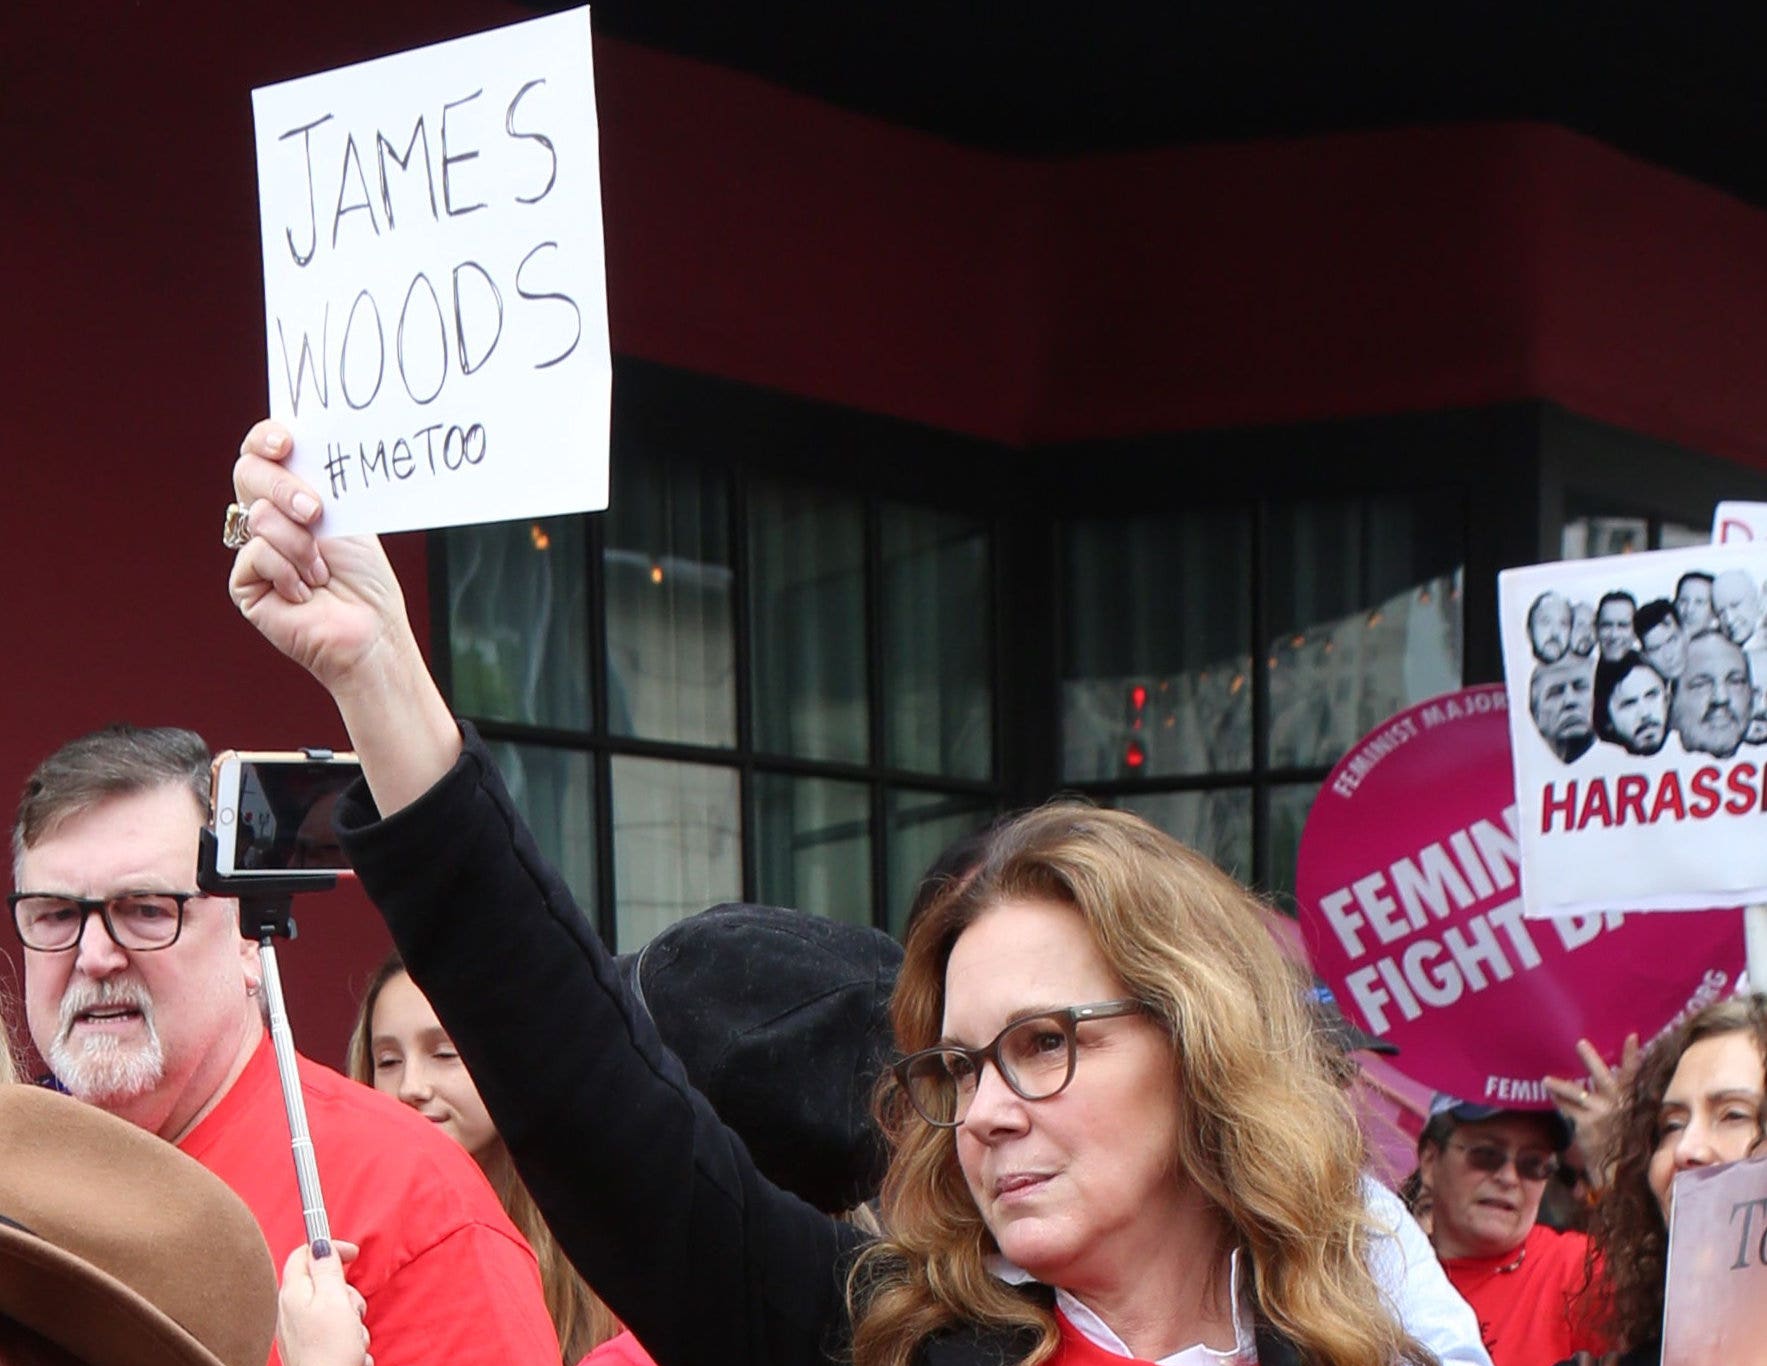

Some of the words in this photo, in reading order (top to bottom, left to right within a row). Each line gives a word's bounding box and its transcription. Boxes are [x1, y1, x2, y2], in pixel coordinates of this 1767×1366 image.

[279, 79, 557, 267] JAMES
[277, 241, 581, 417] WOODS
[1332, 717, 1418, 799] FEMINIST
[1345, 896, 1542, 1037] FIGHT
